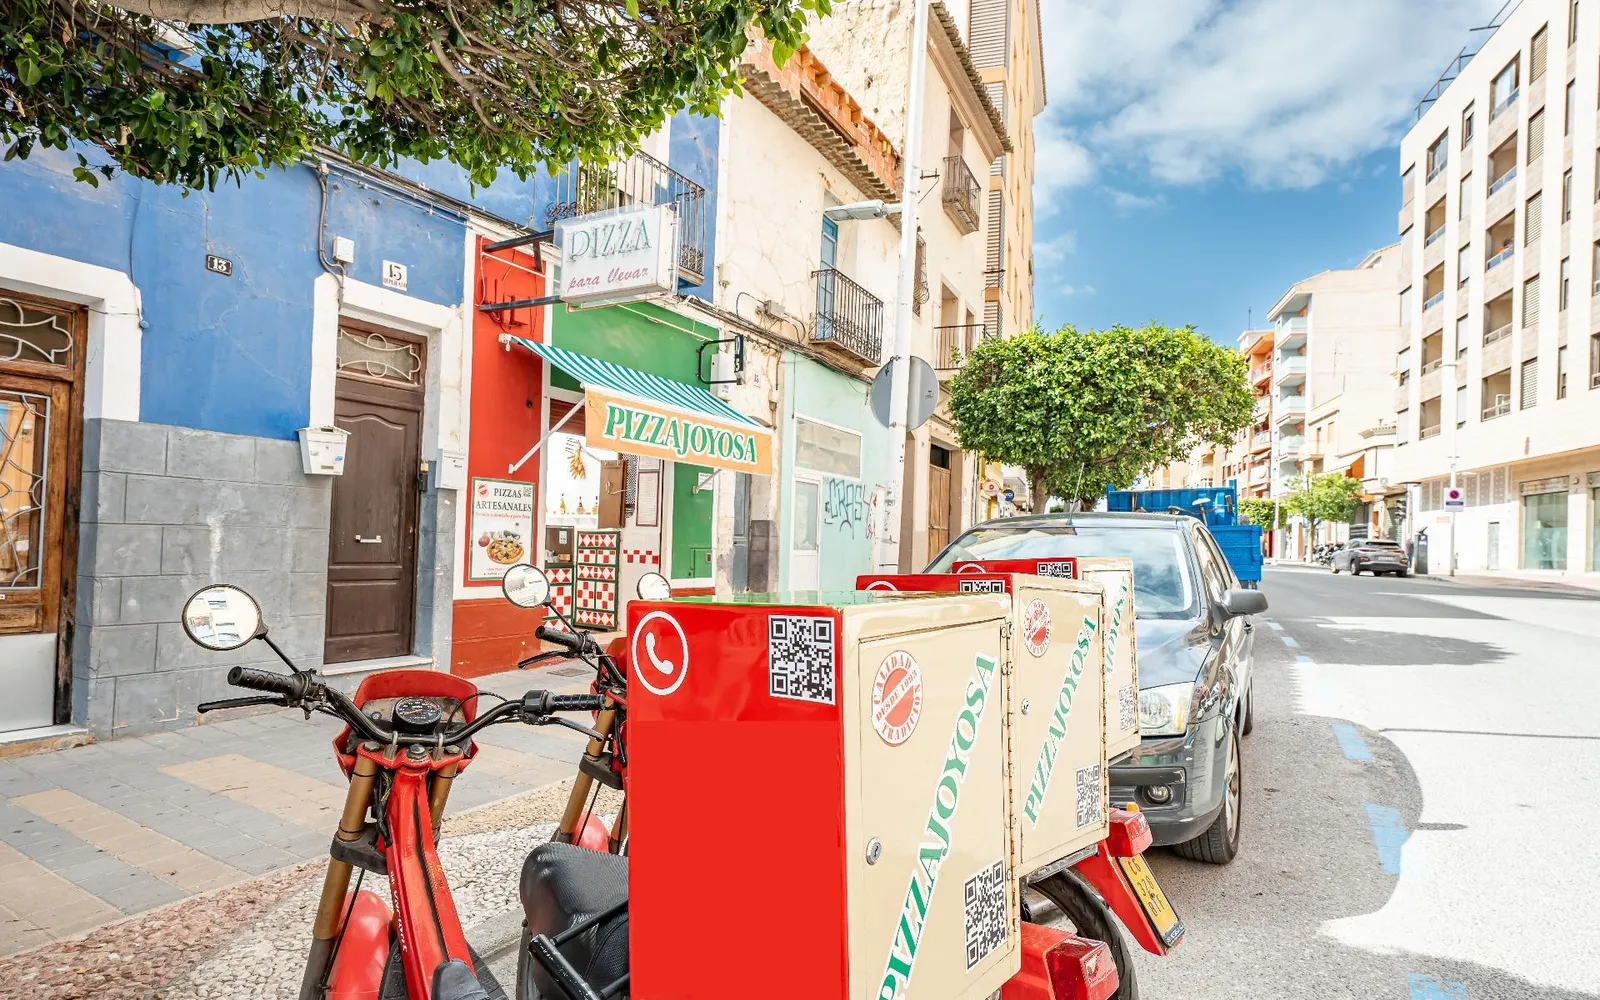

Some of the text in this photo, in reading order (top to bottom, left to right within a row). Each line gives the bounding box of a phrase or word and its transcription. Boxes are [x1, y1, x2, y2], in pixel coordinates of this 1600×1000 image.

[565, 218, 652, 262] PIZZA
[212, 257, 227, 272] 13
[567, 267, 648, 293] para llevar
[603, 404, 757, 463] PIZZAJOYOSA
[475, 501, 532, 512] ARTESANALES
[493, 487, 522, 498] PIZZAS
[874, 654, 912, 705] CALIDAD
[876, 690, 900, 721] DESDE
[1023, 617, 1097, 824] PIZZAJOYOSA
